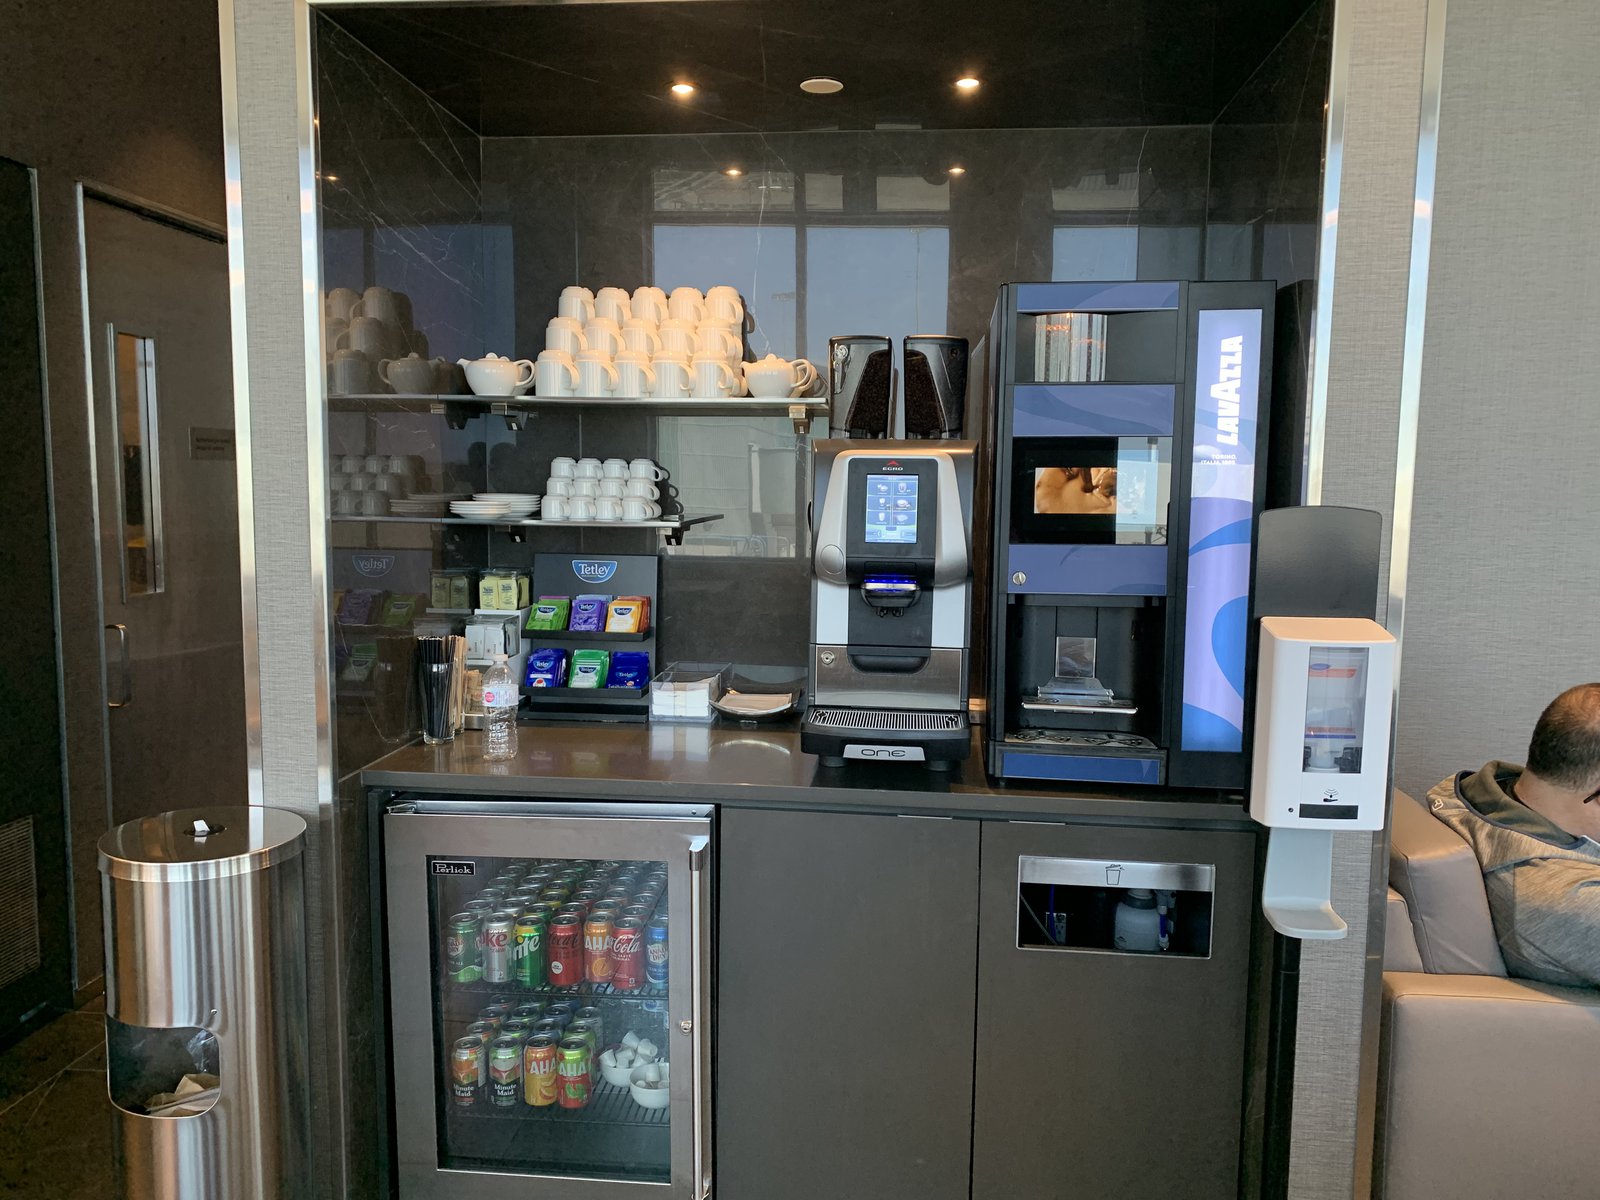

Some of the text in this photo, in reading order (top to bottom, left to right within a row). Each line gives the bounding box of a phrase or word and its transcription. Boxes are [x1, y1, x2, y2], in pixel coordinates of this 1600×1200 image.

[1209, 335, 1243, 446] LAVAZZA
[578, 563, 611, 578] Tetley
[435, 863, 472, 874] Perlick
[529, 1057, 556, 1075] AHA
[559, 1061, 587, 1077] AHA
[494, 1083, 517, 1091] Minute
[497, 1088, 514, 1096] Maid
